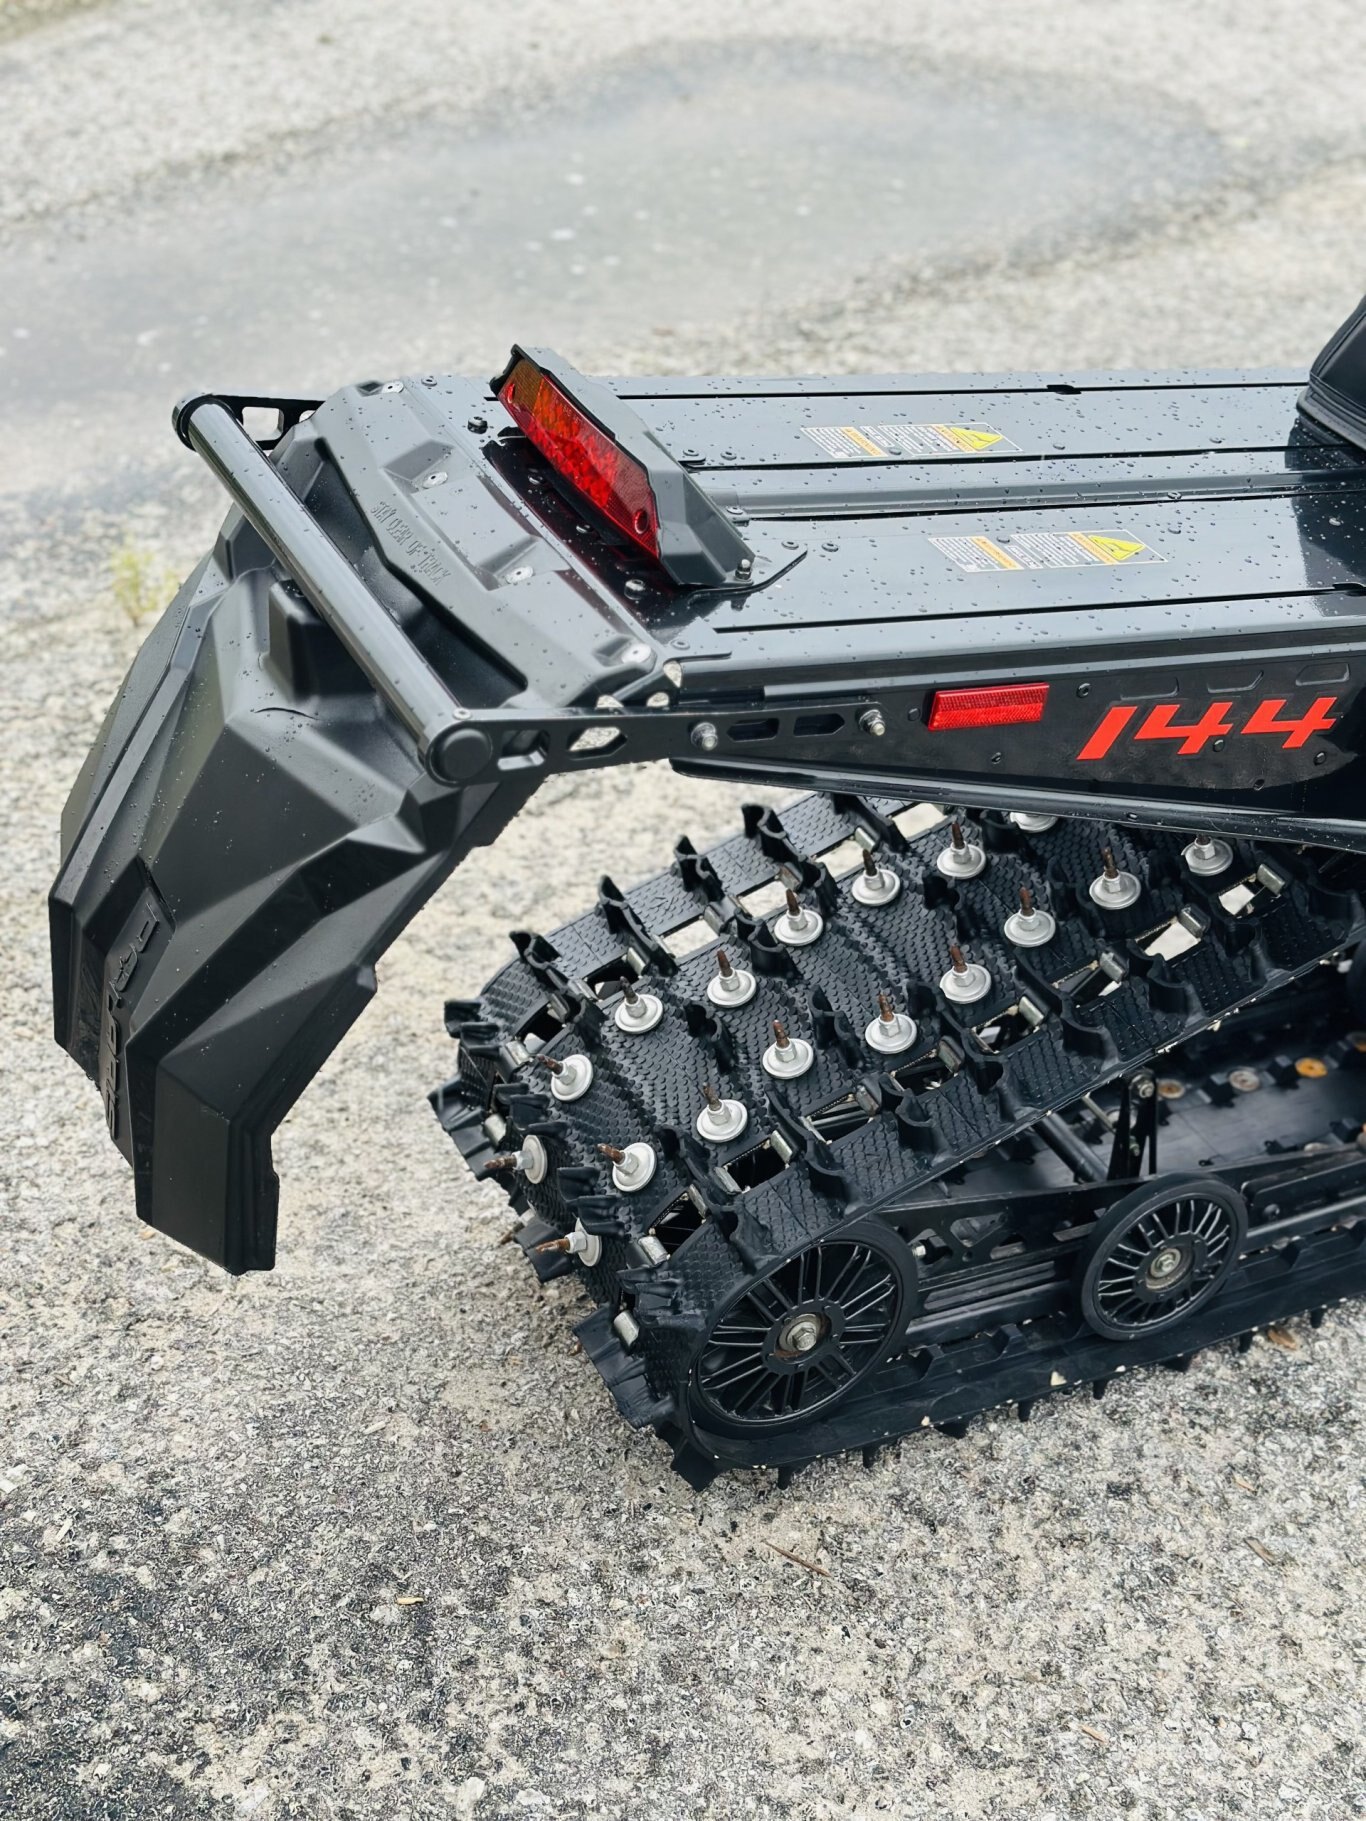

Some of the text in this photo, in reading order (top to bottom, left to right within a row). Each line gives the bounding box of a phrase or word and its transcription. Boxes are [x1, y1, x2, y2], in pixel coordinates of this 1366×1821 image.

[370, 501, 452, 586] STAY CLEAR OF TRACK
[1077, 697, 1337, 760] 144
